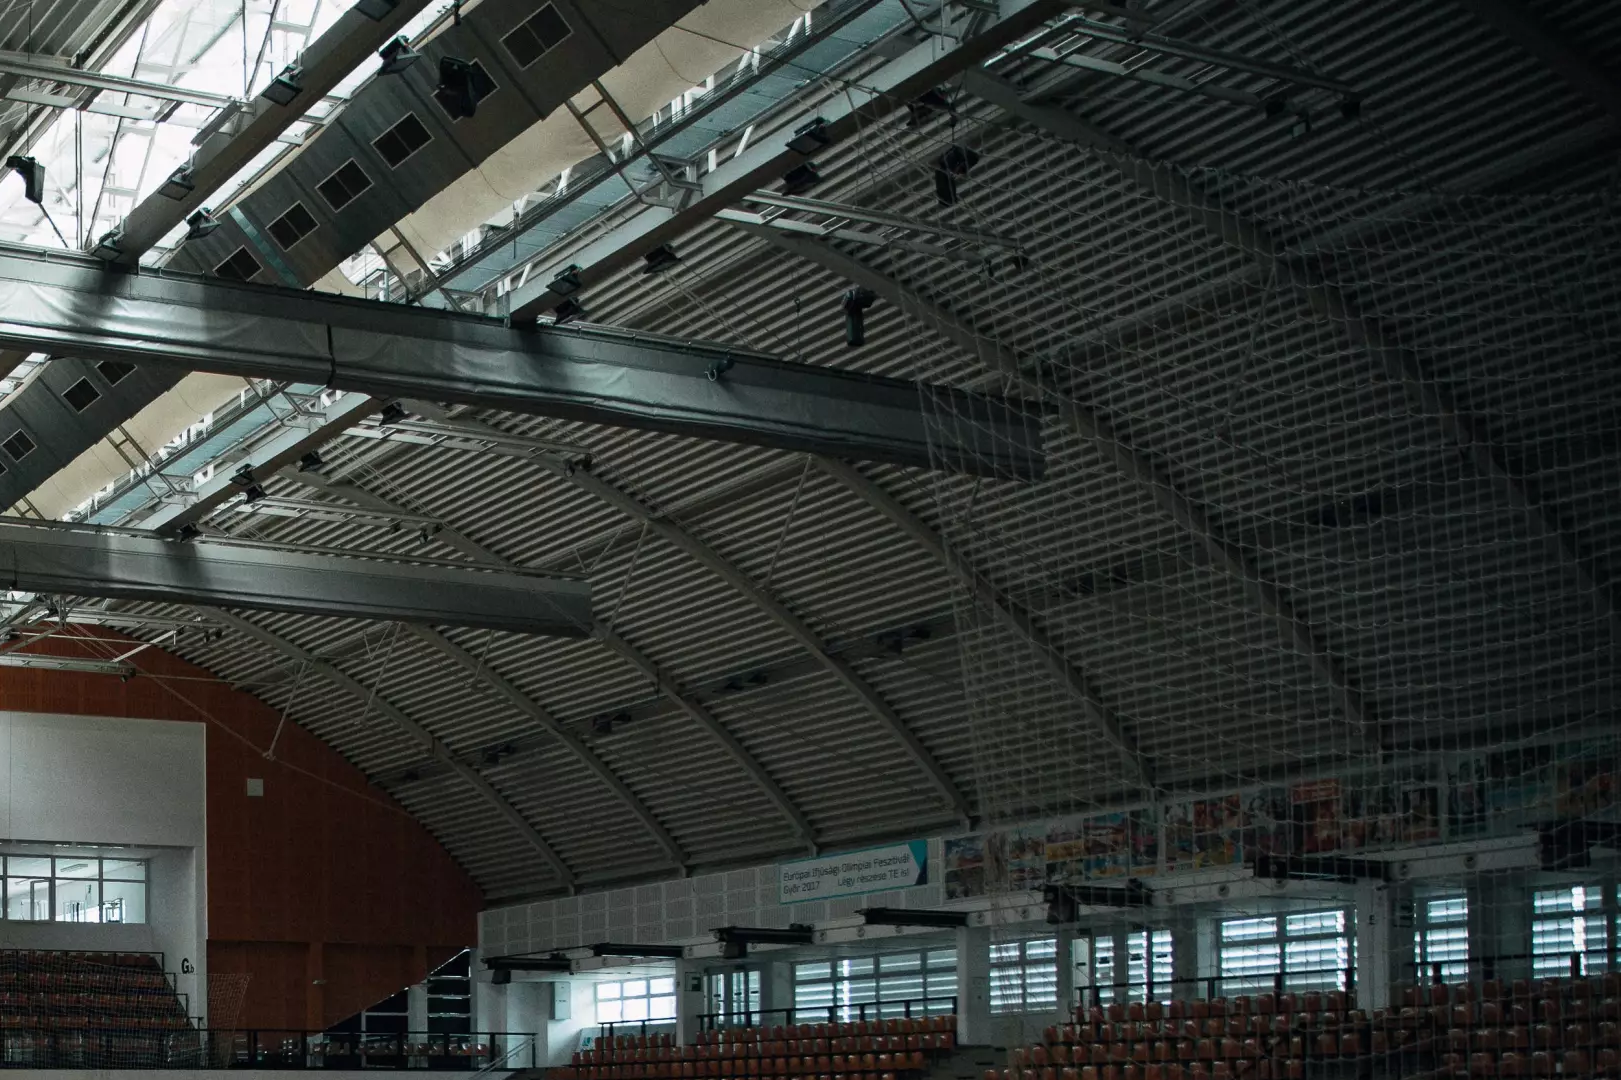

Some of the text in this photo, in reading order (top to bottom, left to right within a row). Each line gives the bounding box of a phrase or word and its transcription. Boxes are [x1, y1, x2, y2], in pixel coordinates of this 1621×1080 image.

[783, 870, 811, 882] Európai
[841, 860, 872, 873] Olimpiai
[873, 853, 910, 868] Fesztivál
[888, 869, 899, 879] TE
[801, 881, 820, 893] 2017
